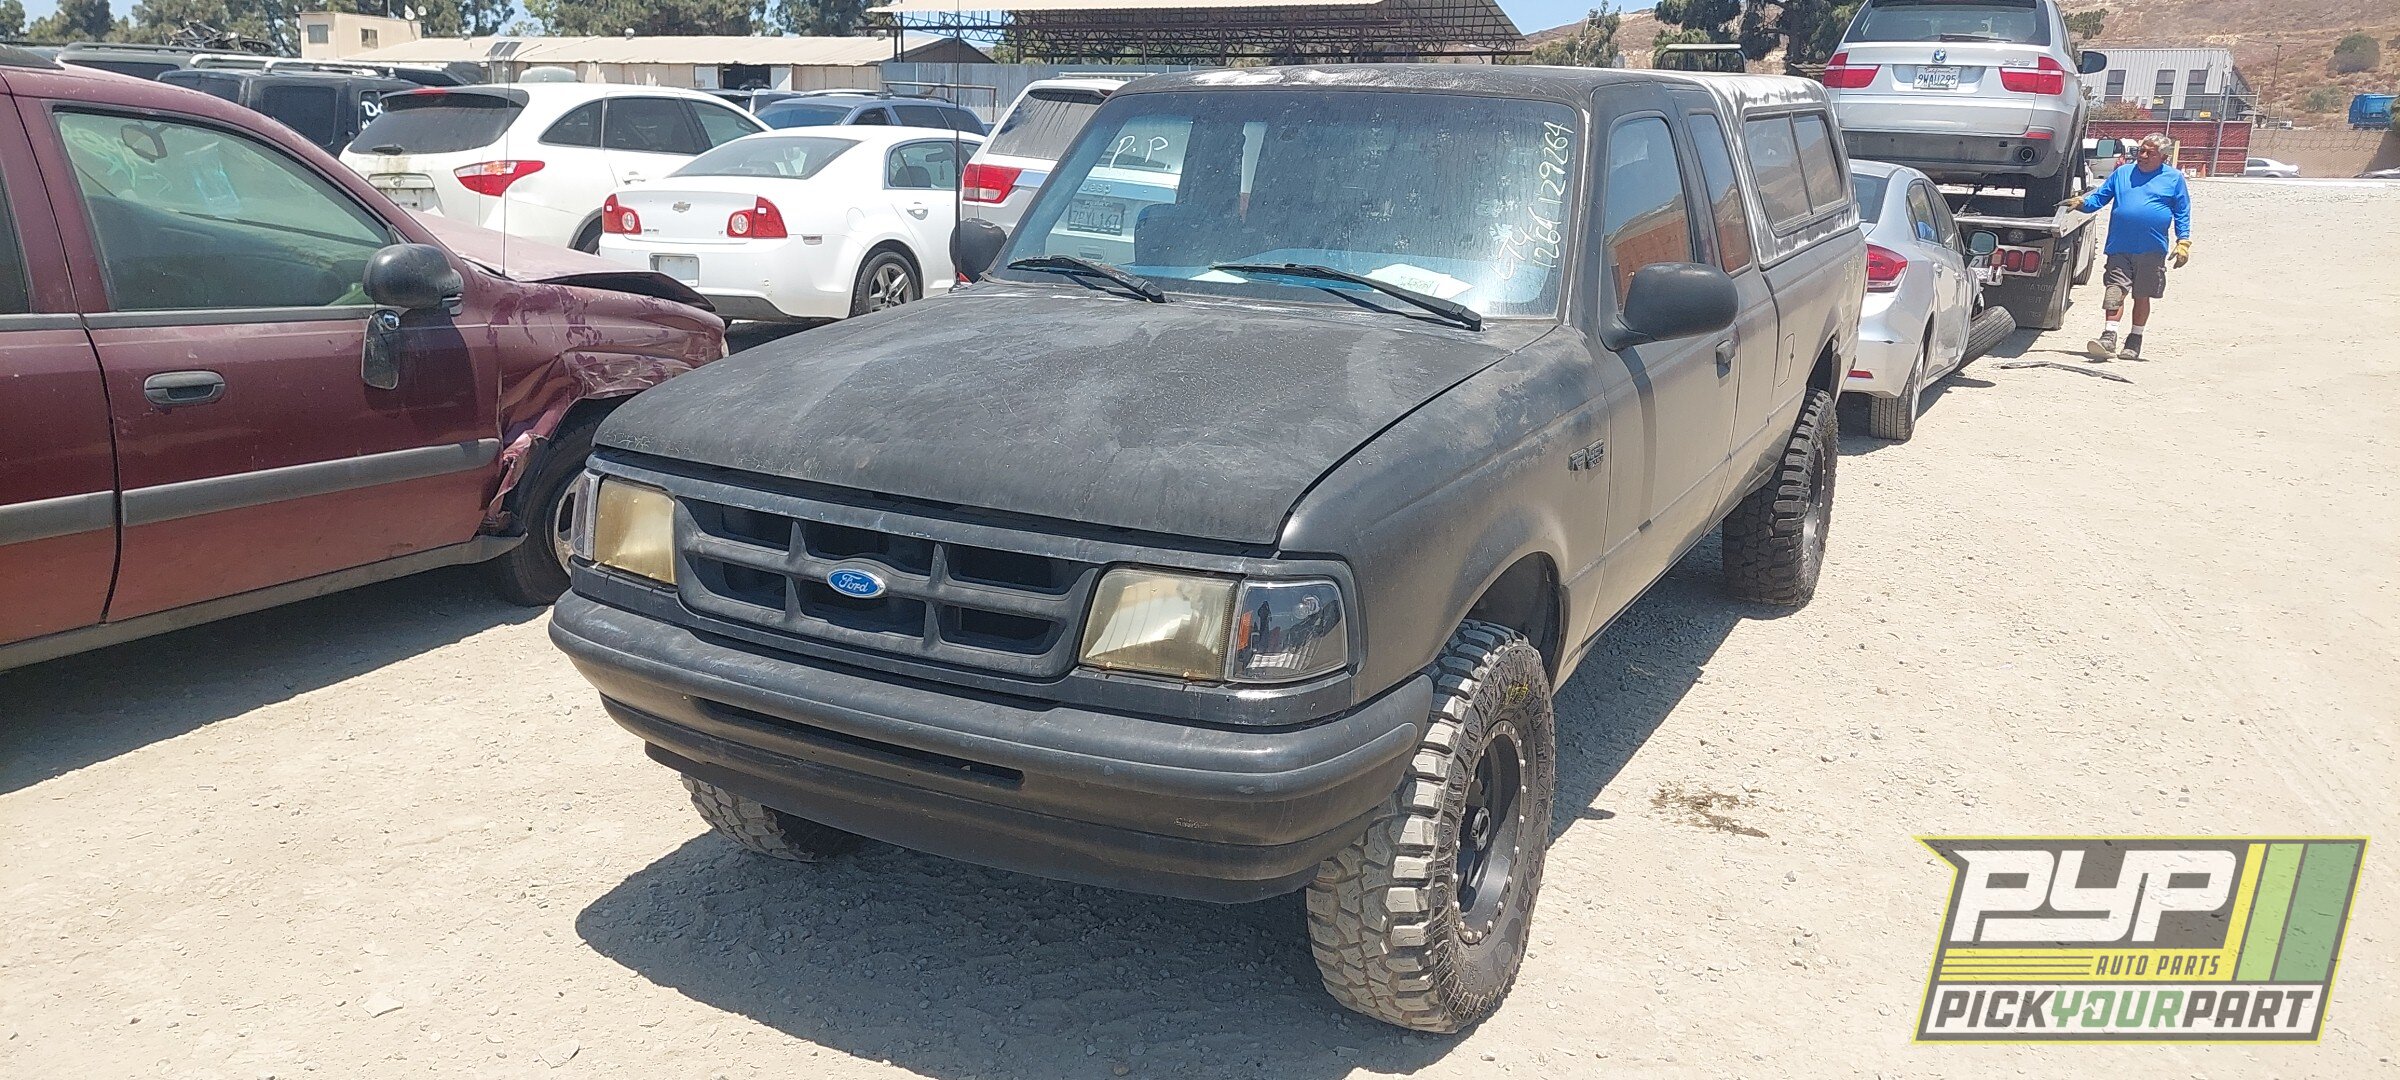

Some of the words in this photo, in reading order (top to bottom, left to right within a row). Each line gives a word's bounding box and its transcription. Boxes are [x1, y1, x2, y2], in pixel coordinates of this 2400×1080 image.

[1917, 74, 1957, 85] 9WAU295
[1081, 182, 1111, 194] Jeep
[838, 573, 869, 592] Ford
